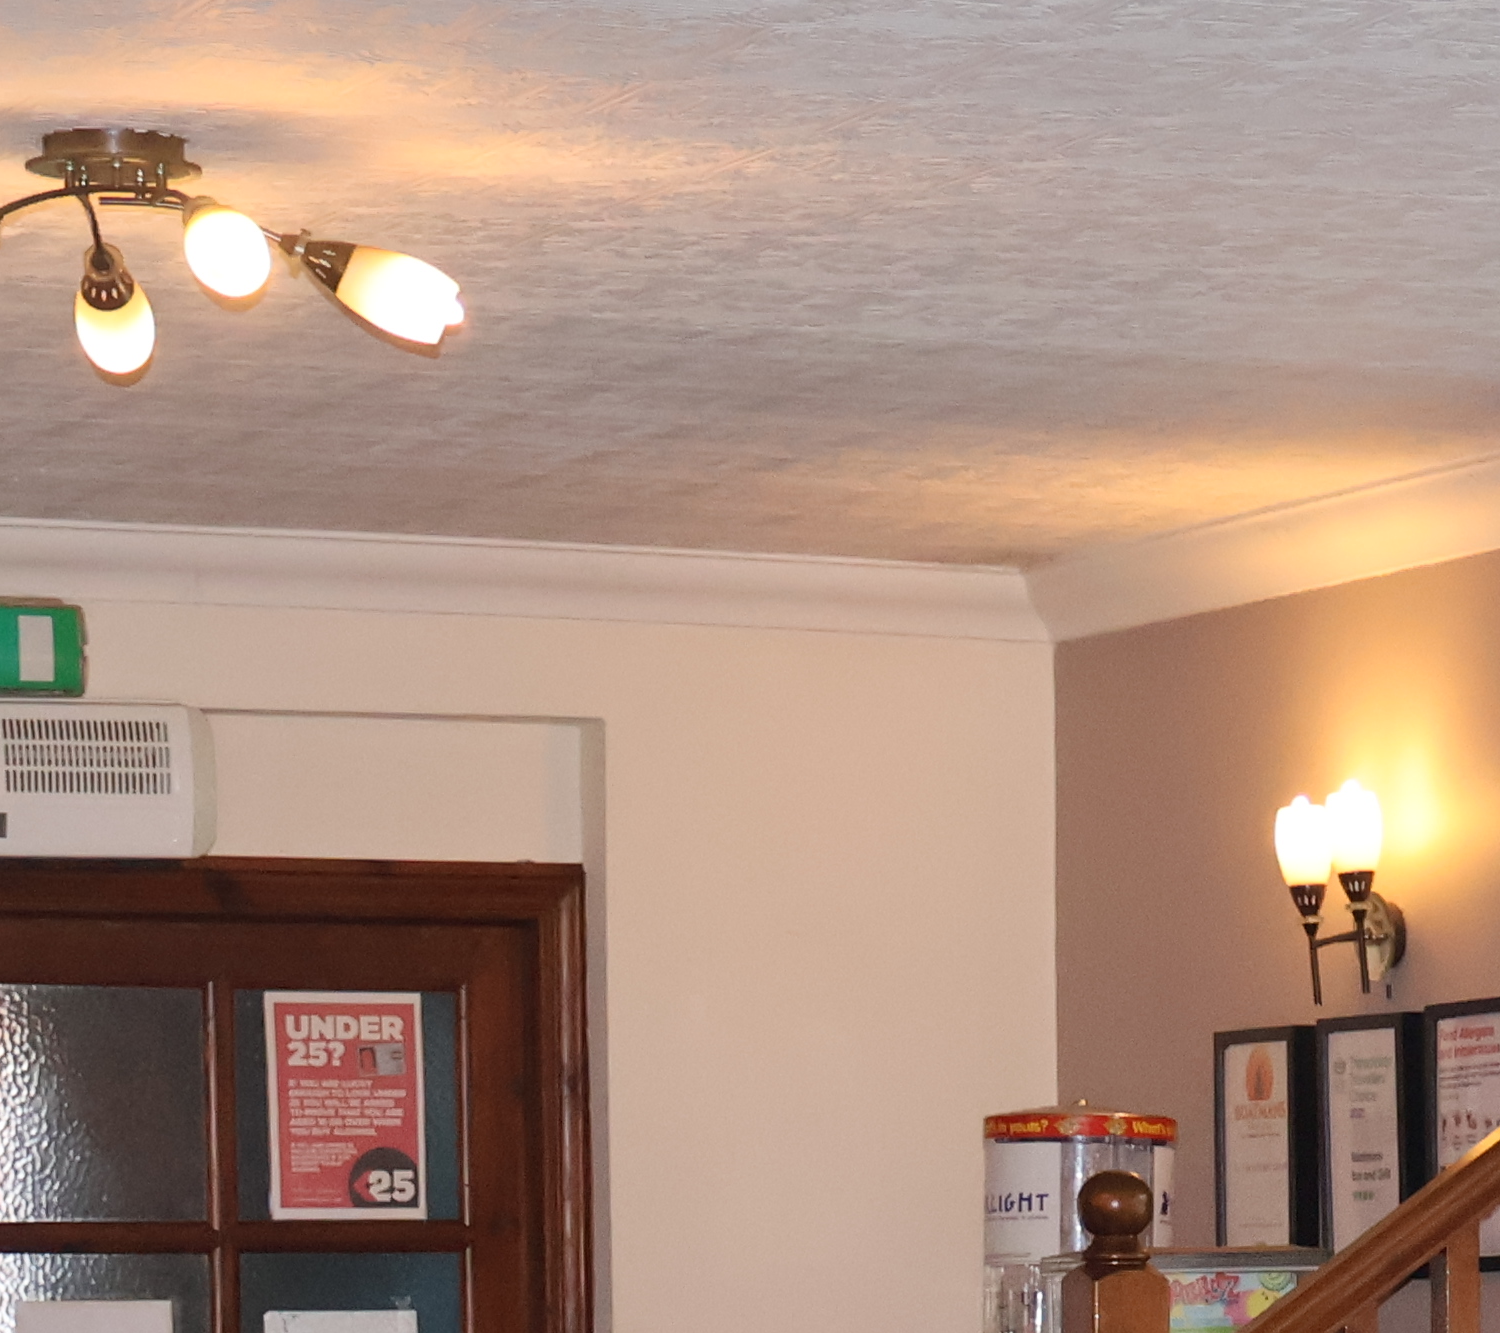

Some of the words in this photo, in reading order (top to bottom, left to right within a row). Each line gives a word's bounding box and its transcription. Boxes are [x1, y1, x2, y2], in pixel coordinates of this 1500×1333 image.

[284, 1014, 405, 1042] UNDER
[286, 1041, 346, 1067] 25?
[368, 1169, 416, 1203] 25
[985, 1192, 1050, 1215] LIGHT
